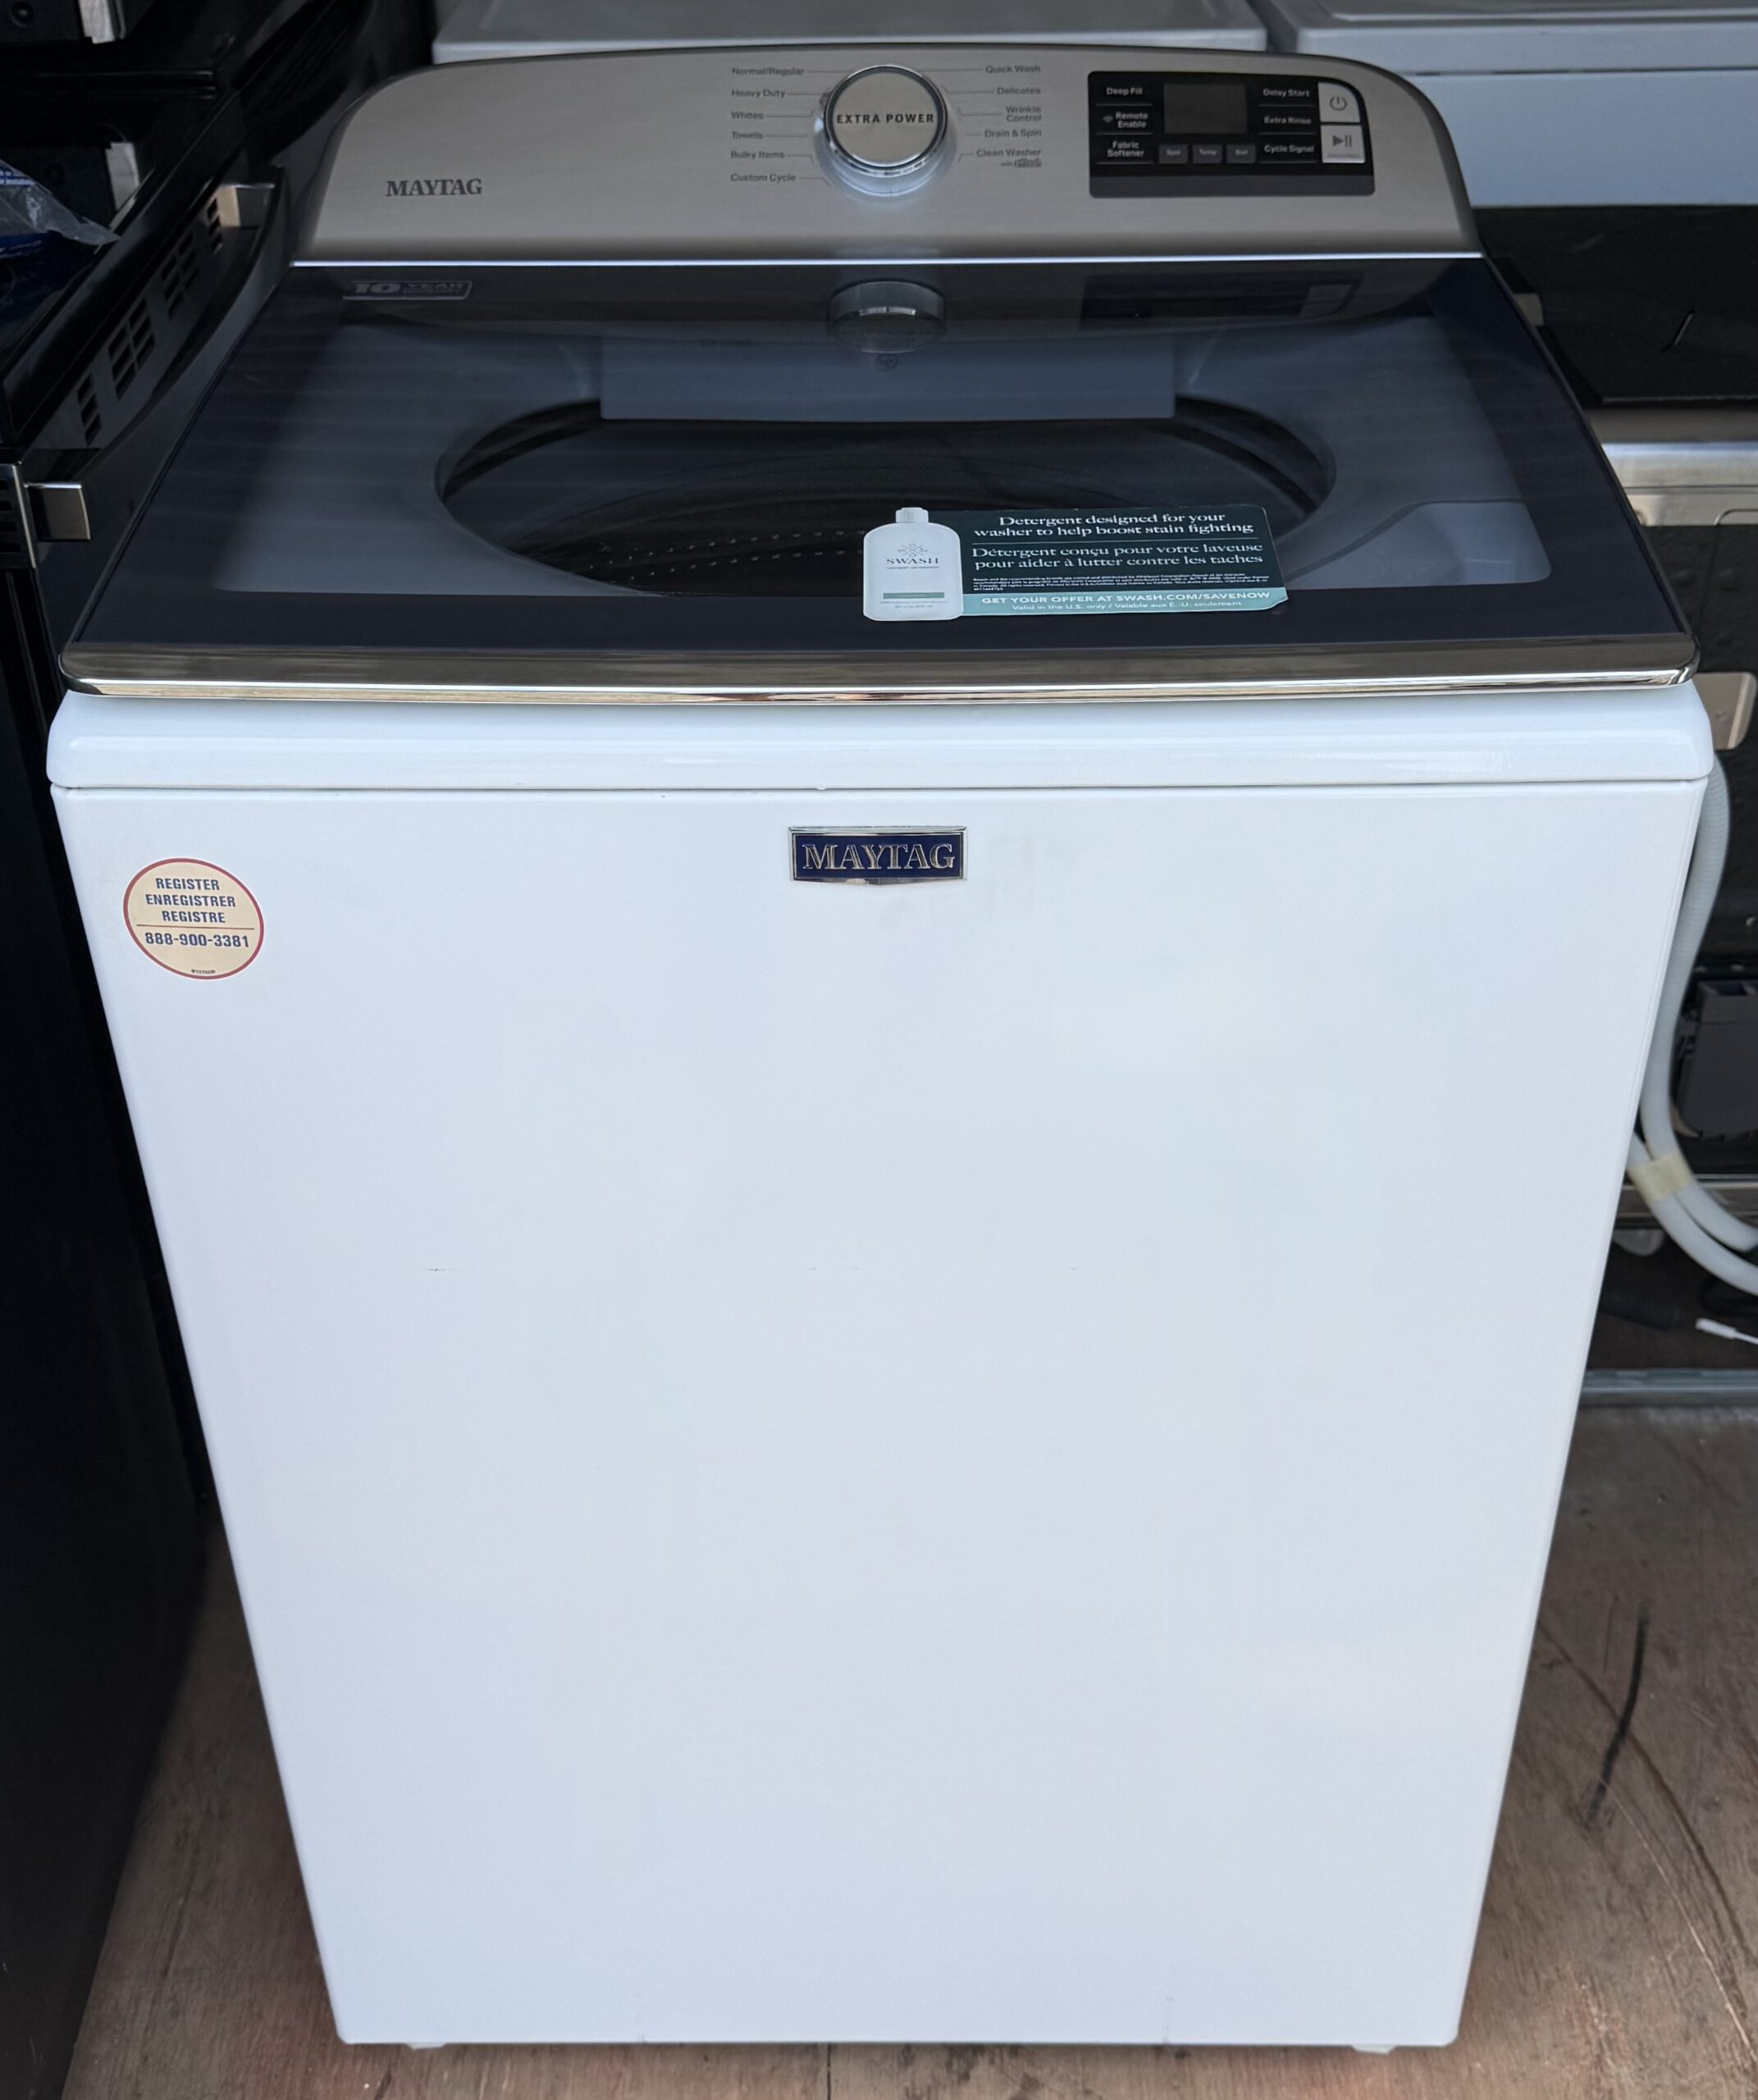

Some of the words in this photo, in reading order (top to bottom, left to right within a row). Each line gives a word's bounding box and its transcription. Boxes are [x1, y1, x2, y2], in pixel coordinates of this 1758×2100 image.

[732, 67, 805, 76] Normal/Regular
[985, 66, 1012, 74] Quick
[731, 89, 761, 98] Heavy
[762, 89, 786, 98] Duty
[997, 87, 1041, 95] Delicates
[1106, 87, 1130, 96] Deep
[1130, 87, 1144, 95] Fill
[1263, 89, 1286, 98] Delay
[1288, 89, 1310, 98] Start
[731, 112, 764, 120] Whites
[836, 113, 880, 124] EXTRA
[885, 113, 934, 124] POWER
[1006, 114, 1042, 122] Control
[1116, 112, 1148, 120] Remote
[1264, 116, 1287, 125] Extra
[1117, 121, 1147, 129] Enable
[732, 131, 763, 139] Towels
[984, 130, 1011, 138] Drain
[1020, 129, 1042, 139] Spin
[1112, 141, 1139, 149] Fabric
[1264, 144, 1288, 153] Cycle
[1289, 144, 1315, 154] Signal
[730, 150, 757, 159] Bulky
[757, 150, 785, 158] Items
[976, 148, 1004, 157] Clean
[1005, 148, 1042, 157] Washer
[1107, 149, 1145, 158] Softener
[730, 173, 769, 182] Custom
[769, 173, 797, 183] Cycle
[386, 178, 482, 197] MAYTAG
[354, 282, 401, 294] 10
[999, 516, 1083, 527] Detergent
[1085, 514, 1158, 525] designed
[1162, 514, 1185, 523] for
[1189, 514, 1226, 524] your
[974, 527, 1033, 536] washer
[1057, 526, 1093, 537] help
[1096, 526, 1142, 534] boost
[1145, 524, 1185, 533] stain
[1188, 523, 1254, 535] fighting
[972, 547, 1057, 559] Détergent
[1060, 548, 1109, 557] conçu
[1114, 547, 1153, 557] pour
[1156, 546, 1199, 554] votre
[1203, 544, 1263, 553] laveuse
[975, 560, 1015, 571] pour
[1018, 559, 1061, 568] aider
[1064, 558, 1074, 567] à
[1077, 558, 1124, 567] lutter
[1126, 558, 1180, 566] contre
[1184, 555, 1207, 565] les
[1210, 555, 1263, 564] taches
[1116, 591, 1270, 602] SWASH.COM/SAVENOW
[801, 844, 955, 870] MAYTAG
[155, 878, 220, 891] REGISTER
[145, 894, 236, 907] ENREGISTRER
[162, 911, 226, 923] REGISTRE
[144, 932, 249, 947] 888-900-3381
